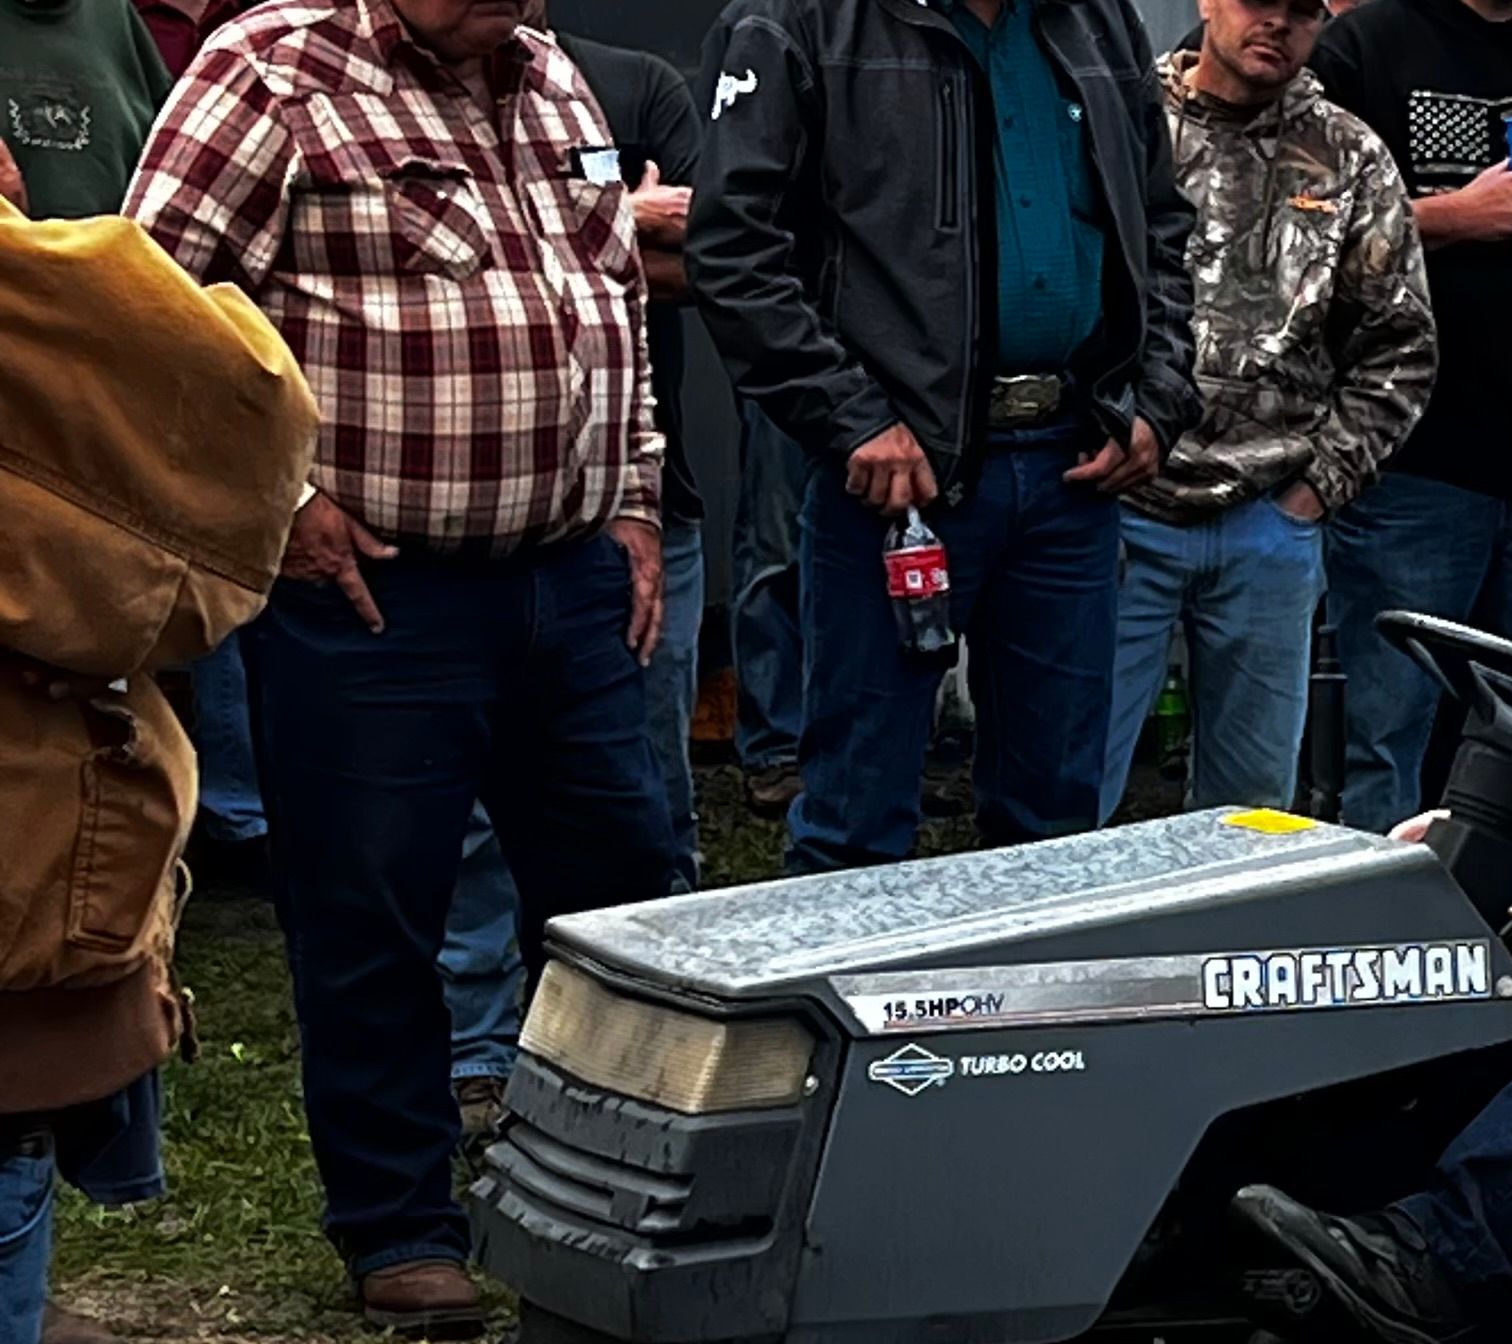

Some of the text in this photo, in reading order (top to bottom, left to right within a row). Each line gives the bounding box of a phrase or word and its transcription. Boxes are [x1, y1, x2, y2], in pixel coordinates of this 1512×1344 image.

[1202, 943, 1488, 1009] CRAFTSMAN
[960, 1052, 1027, 1076] TURBO
[1031, 1050, 1085, 1072] COOL
